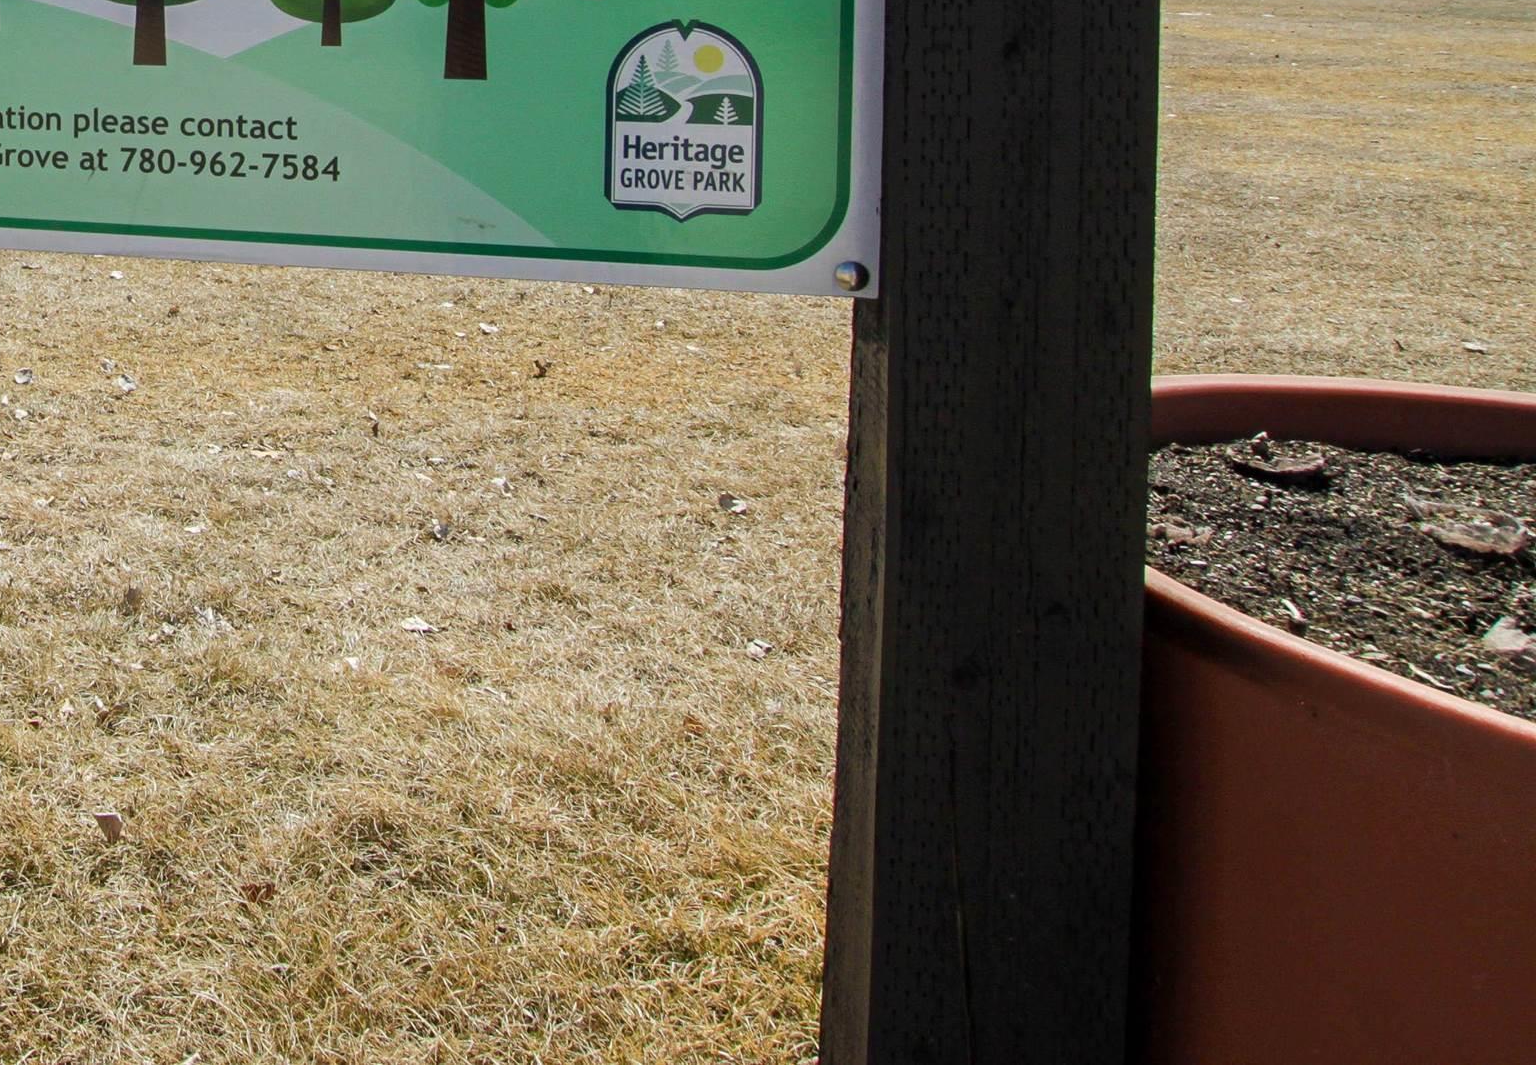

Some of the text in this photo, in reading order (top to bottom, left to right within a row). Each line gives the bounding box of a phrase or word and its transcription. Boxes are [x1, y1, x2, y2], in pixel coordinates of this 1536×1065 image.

[73, 108, 170, 139] please
[180, 114, 299, 140] contact
[79, 148, 109, 172] at
[120, 148, 341, 182] 780-962-7584
[623, 135, 745, 170] Heritage
[620, 167, 746, 193] GROVE PARK
